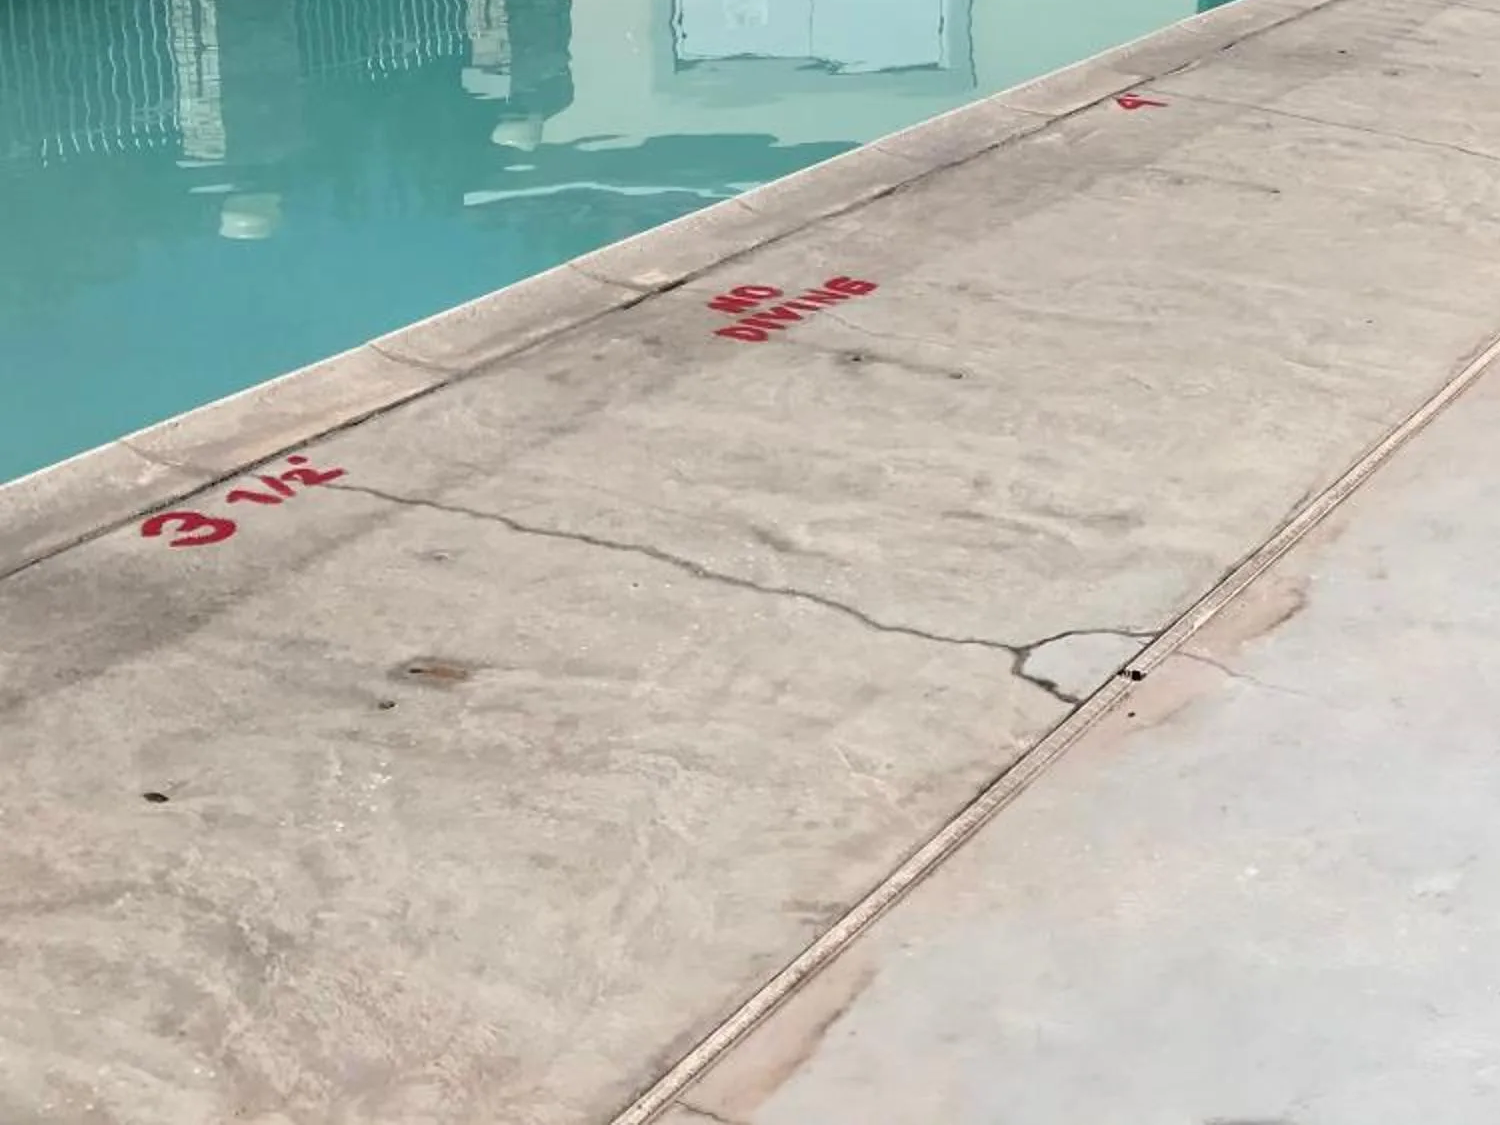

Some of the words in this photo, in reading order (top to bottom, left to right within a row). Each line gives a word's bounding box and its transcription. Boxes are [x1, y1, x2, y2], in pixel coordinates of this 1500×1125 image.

[707, 284, 783, 314] NO
[713, 276, 878, 342] DIVING
[141, 511, 237, 548] 3
